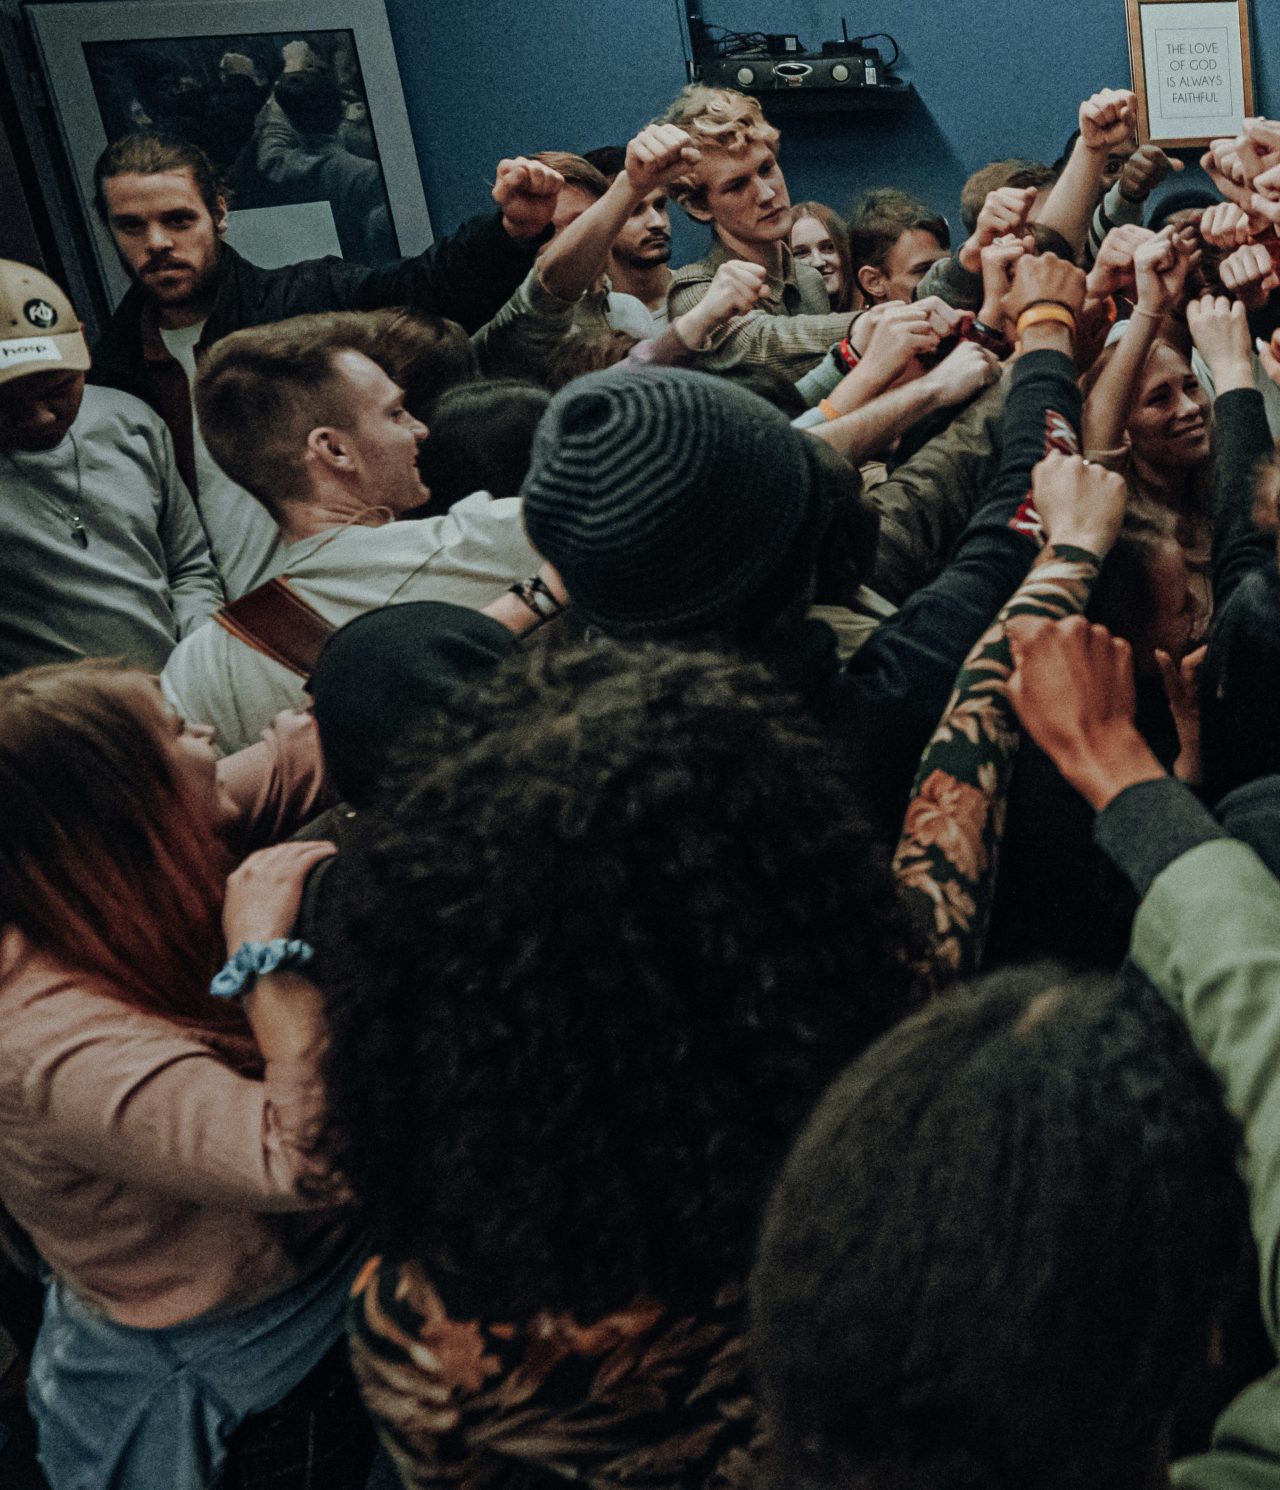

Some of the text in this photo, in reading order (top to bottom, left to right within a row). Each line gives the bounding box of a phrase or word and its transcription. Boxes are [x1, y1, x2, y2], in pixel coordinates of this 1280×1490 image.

[1166, 42, 1218, 55] THE LOVE
[1170, 59, 1217, 71] OF GOD
[1166, 75, 1223, 88] IS ALWAYS
[1172, 92, 1219, 104] FAITHFUL
